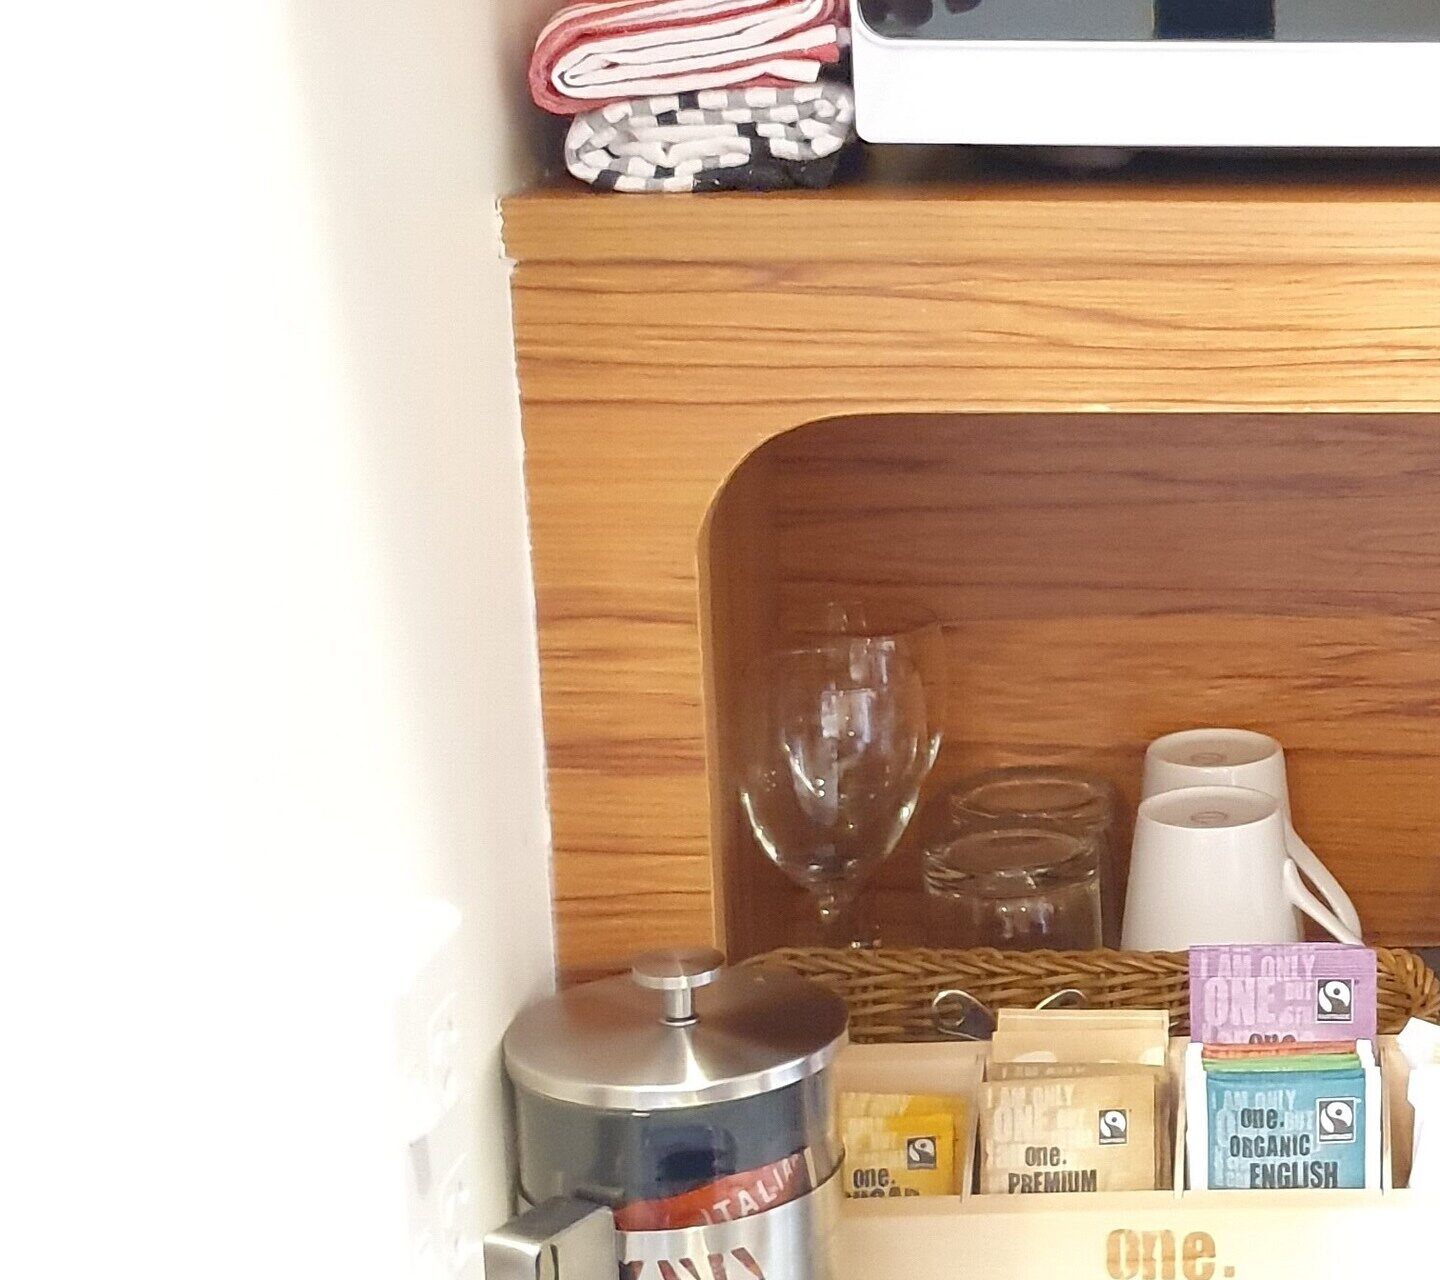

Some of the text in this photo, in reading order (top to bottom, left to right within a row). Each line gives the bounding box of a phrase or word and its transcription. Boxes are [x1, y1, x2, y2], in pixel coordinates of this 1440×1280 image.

[1217, 953, 1252, 978] AM
[1260, 953, 1316, 981] ONLY
[1203, 976, 1277, 1027] ONE
[1254, 1089, 1297, 1111] ONLY
[1240, 1108, 1284, 1129] one.
[1025, 1145, 1067, 1166] one.
[1230, 1133, 1310, 1158] ORGANIC
[853, 1167, 896, 1189] one.
[1008, 1169, 1098, 1194] PREMIUM
[1250, 1160, 1339, 1189] ENGLISH
